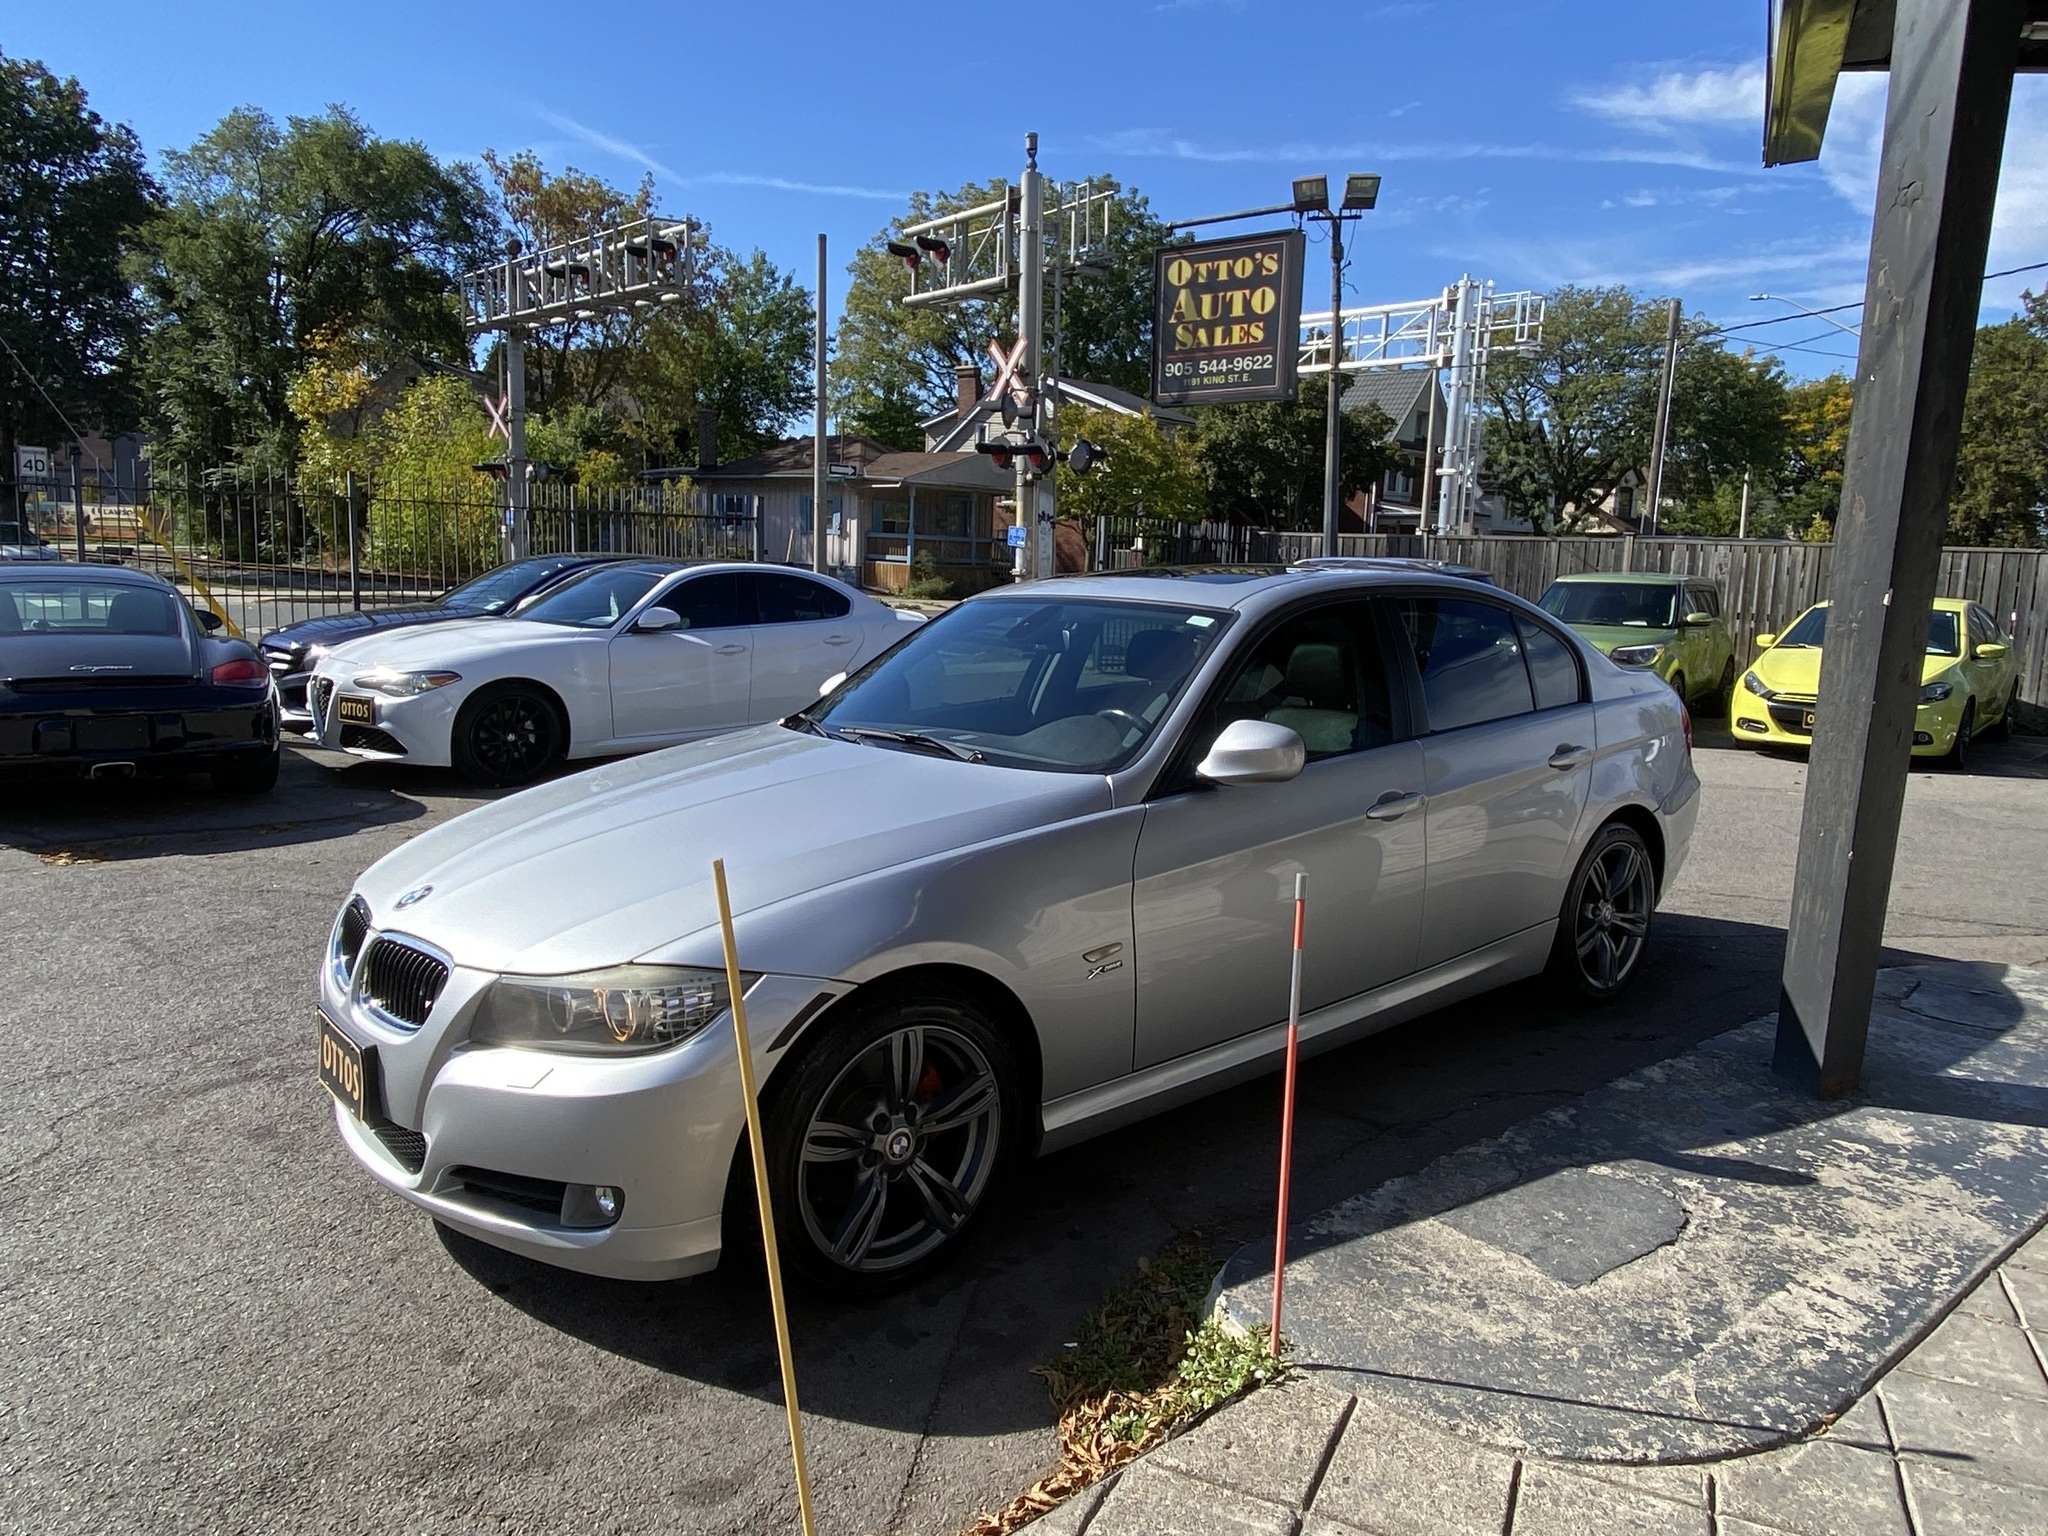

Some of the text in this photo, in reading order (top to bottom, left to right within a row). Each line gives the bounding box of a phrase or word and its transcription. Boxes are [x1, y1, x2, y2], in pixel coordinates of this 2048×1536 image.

[1167, 252, 1279, 287] OTTO'S
[1168, 286, 1276, 324] AUTO
[1175, 322, 1265, 351] SALES
[1165, 355, 1273, 377] 905 544-9622
[1203, 376, 1225, 385] KING
[23, 458, 45, 472] 40
[341, 701, 369, 718] OTTOS
[323, 1033, 359, 1101] OTTOS
